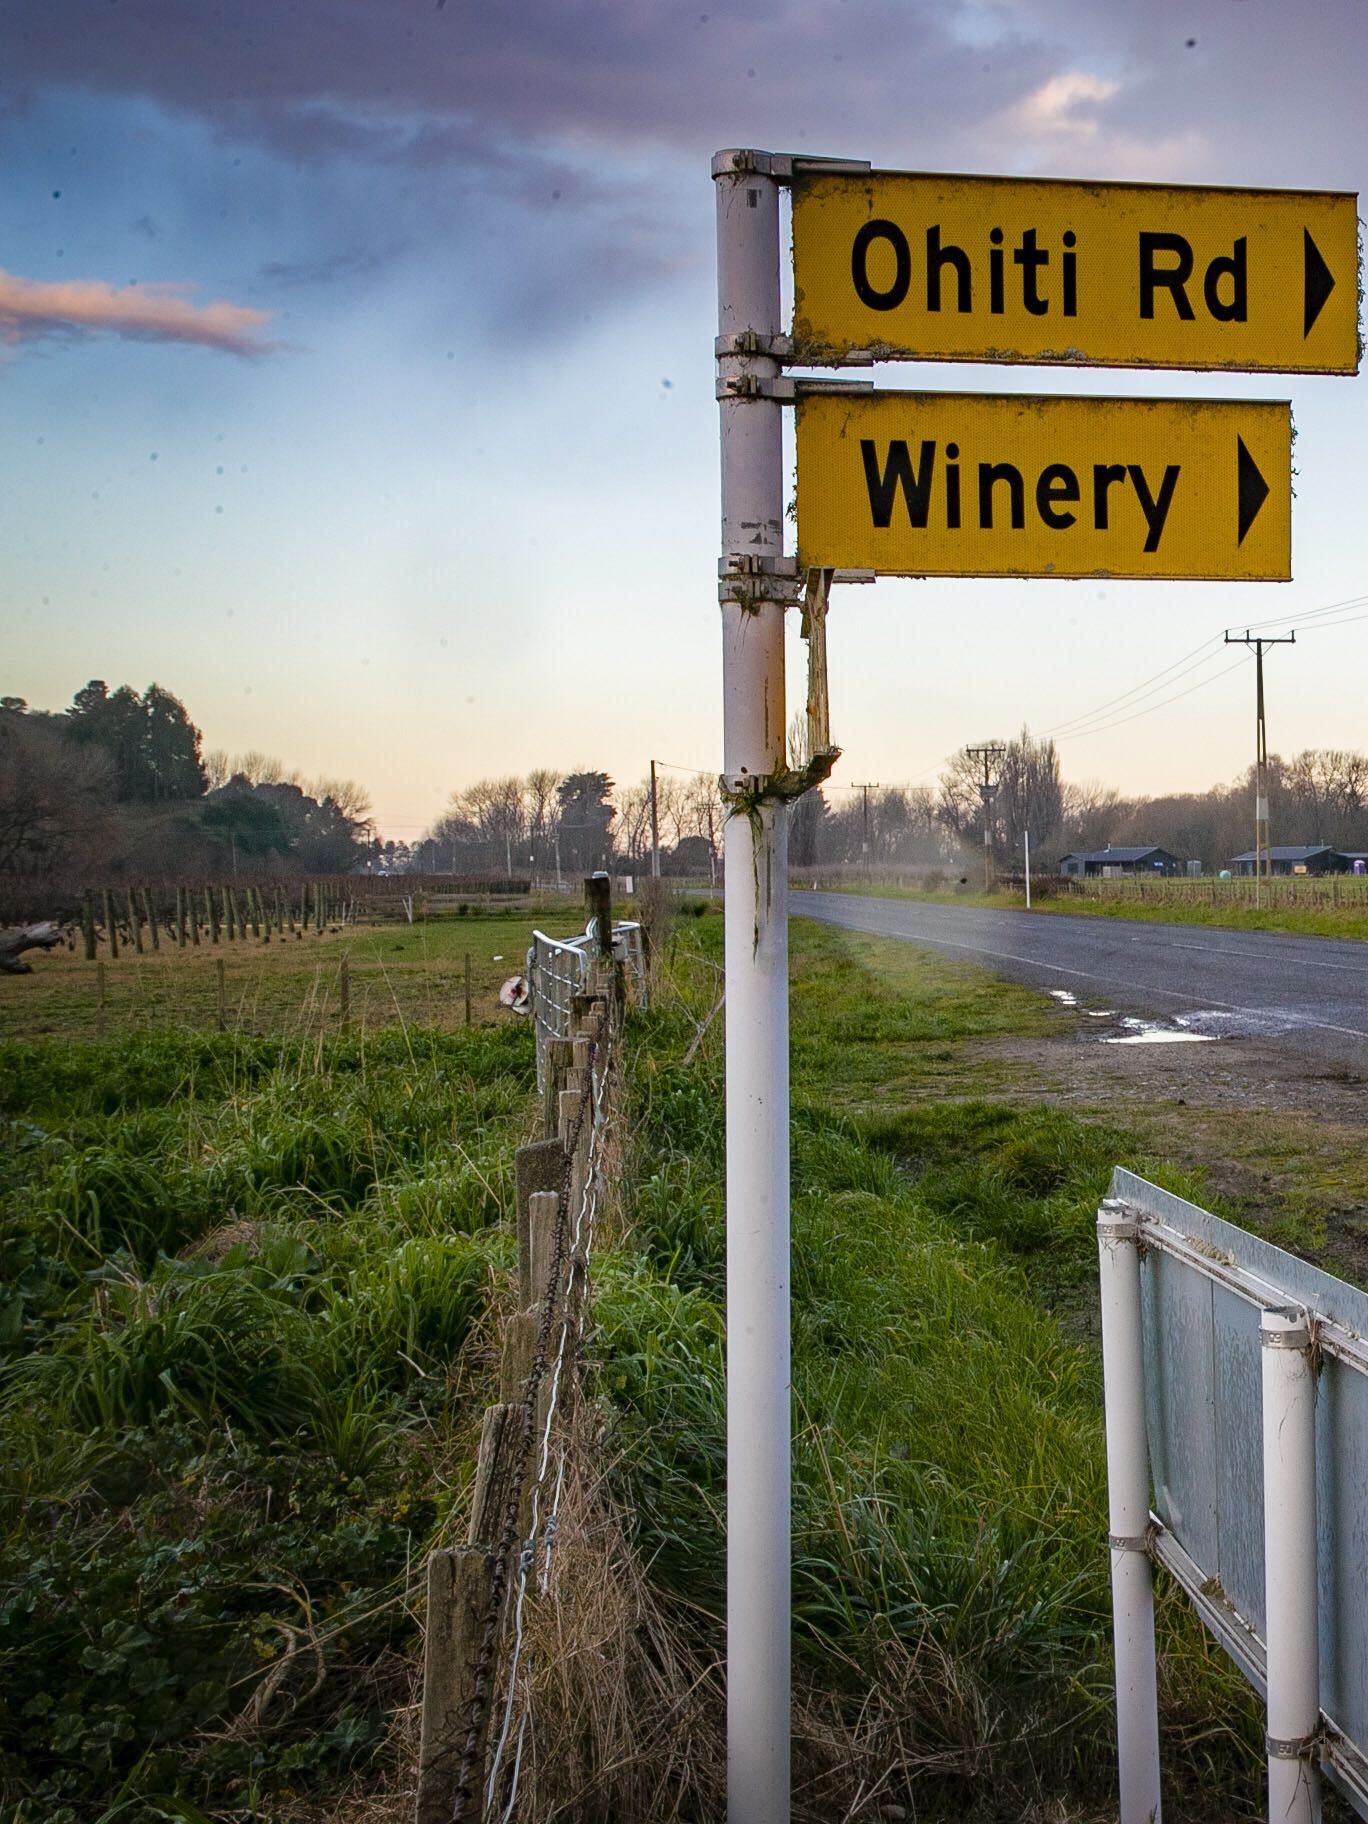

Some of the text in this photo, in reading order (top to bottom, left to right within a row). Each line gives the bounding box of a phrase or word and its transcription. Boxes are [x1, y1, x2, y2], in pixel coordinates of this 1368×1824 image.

[851, 219, 1248, 323] Ohiti Rd
[859, 439, 1181, 553] Winery
